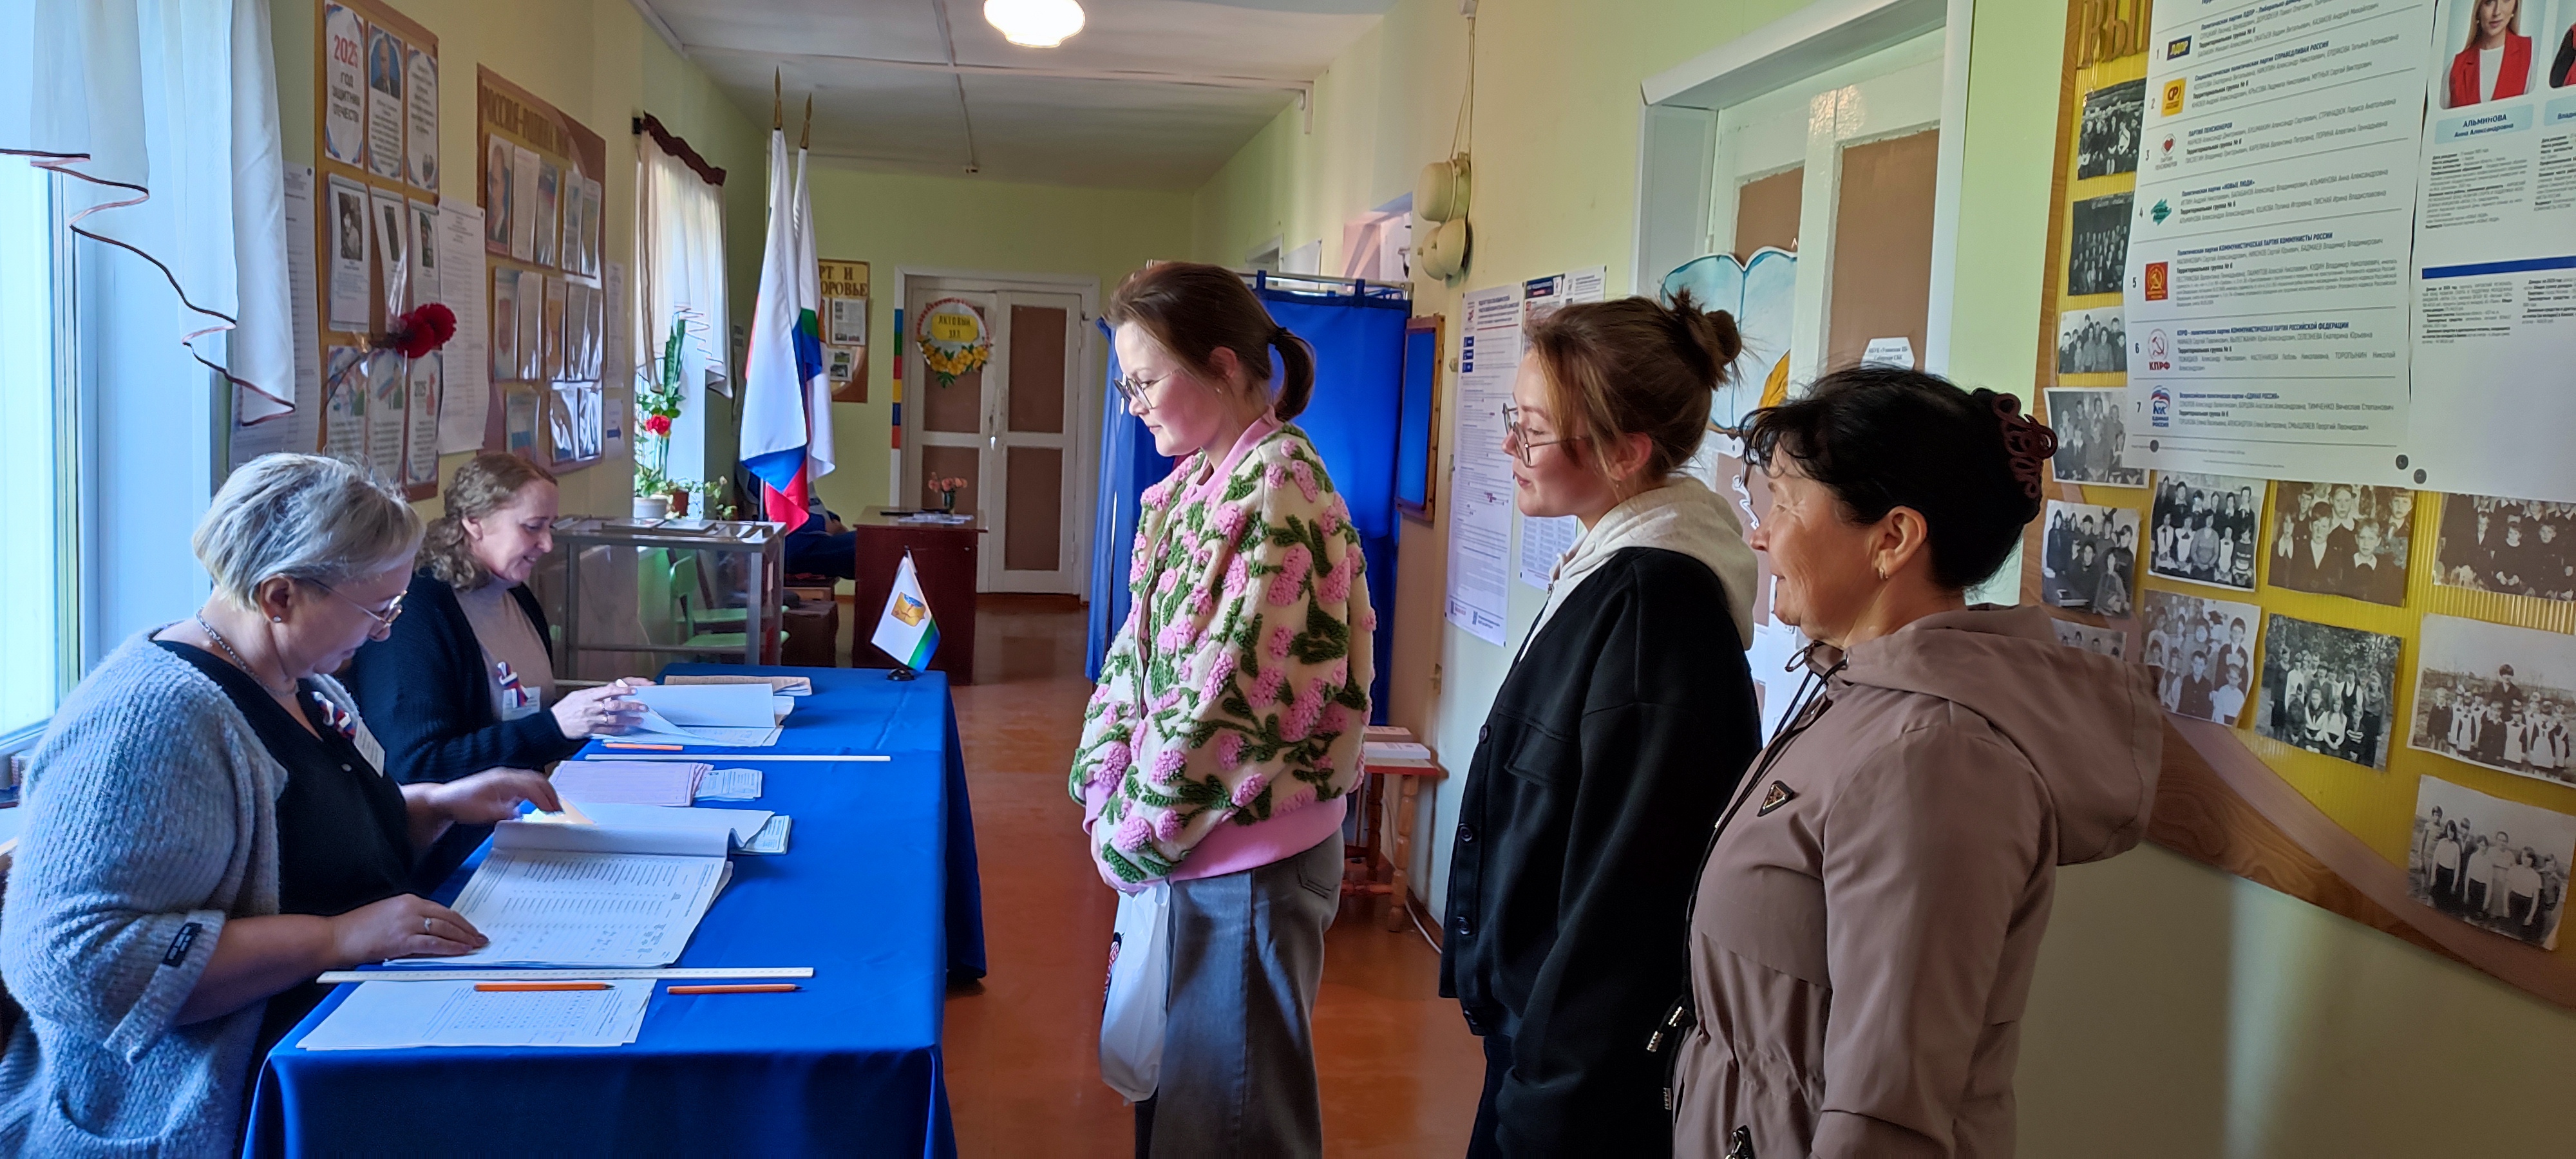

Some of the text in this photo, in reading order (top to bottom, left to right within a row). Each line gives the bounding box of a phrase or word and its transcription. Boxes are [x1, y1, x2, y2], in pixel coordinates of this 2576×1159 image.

[334, 35, 358, 68] 2025
[2310, 41, 2329, 52] РОССИЯ
[2157, 49, 2159, 59] 1
[2151, 98, 2155, 109] 2
[2463, 114, 2506, 127] АЛЬМИНОВА
[2470, 123, 2514, 135] Александровна
[2146, 149, 2150, 161] 3
[2139, 207, 2143, 218] 4
[2280, 234, 2312, 244] КОММУНИСТЫ
[844, 267, 852, 280] И
[2132, 277, 2137, 288] 5
[821, 281, 867, 296] ОРОВЬЕ
[2289, 321, 2317, 330] РОССИЙСКОЙ
[2135, 343, 2139, 353] 6
[2149, 361, 2170, 370] КПРФ
[2137, 402, 2141, 413] 7
